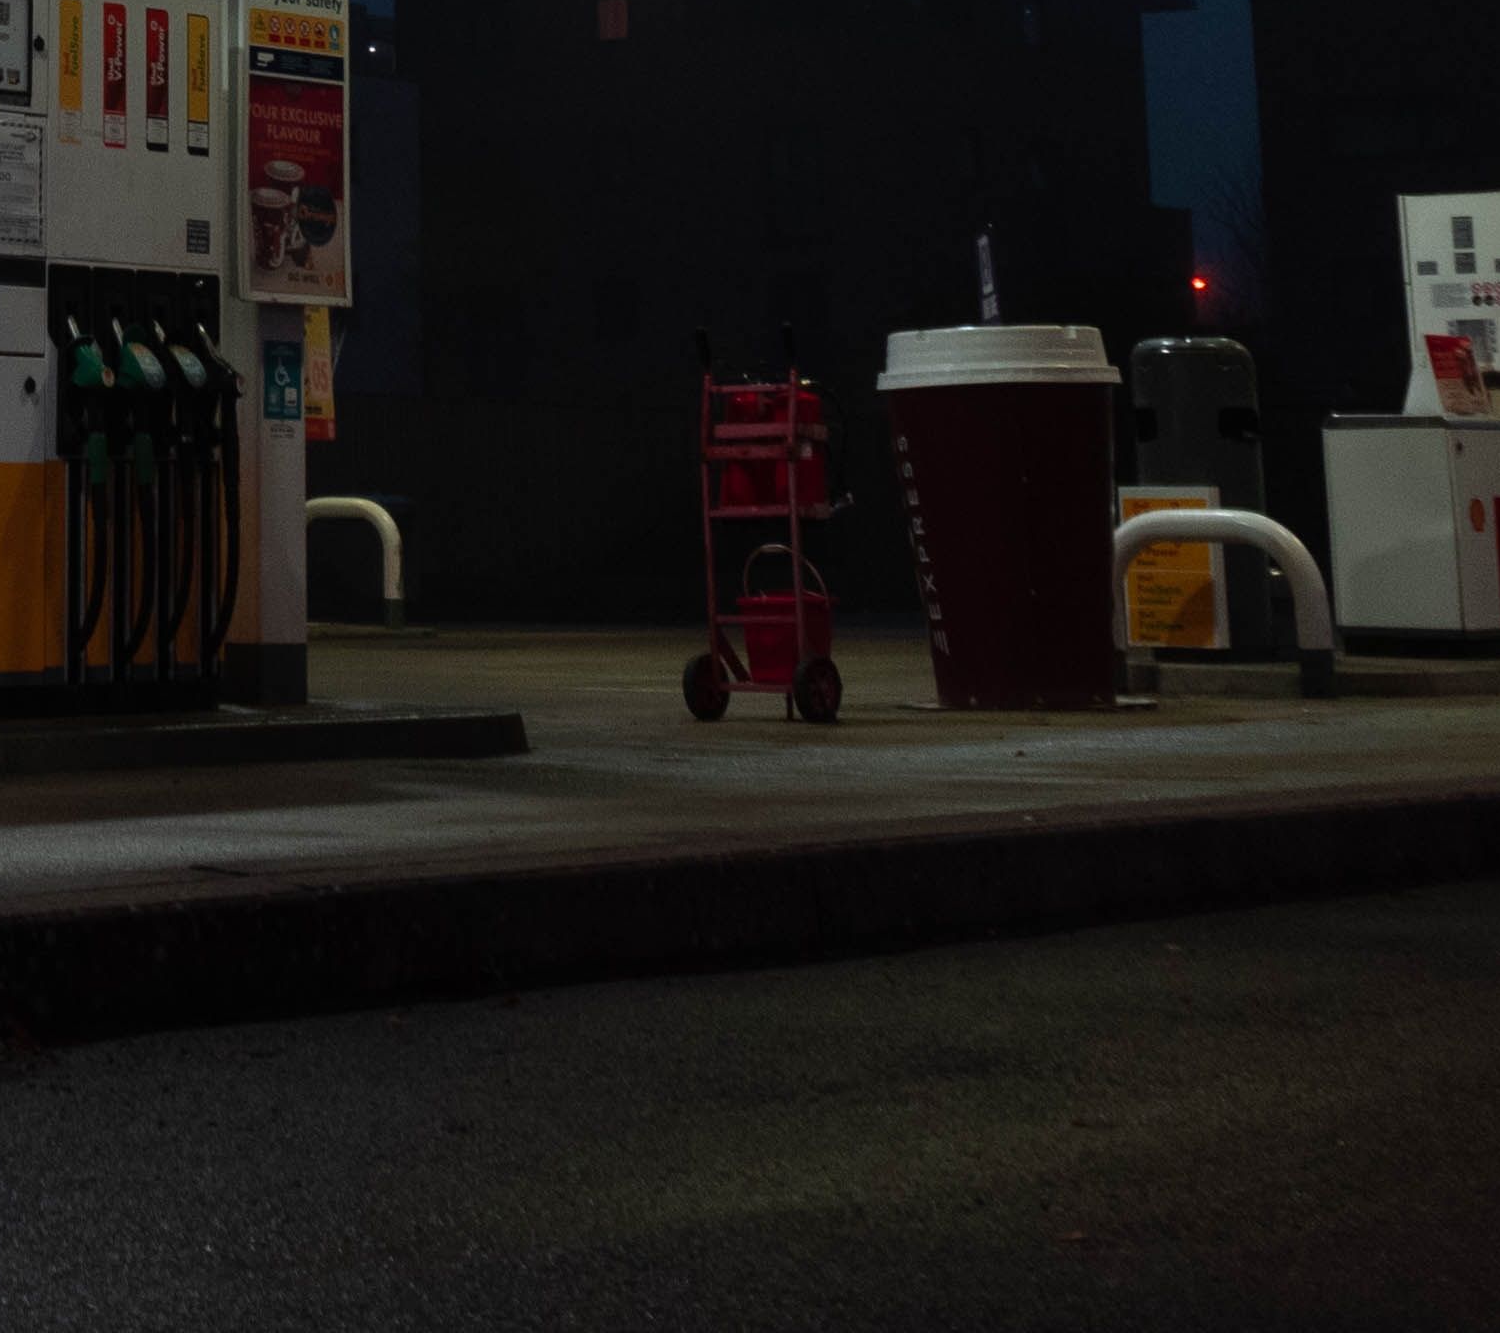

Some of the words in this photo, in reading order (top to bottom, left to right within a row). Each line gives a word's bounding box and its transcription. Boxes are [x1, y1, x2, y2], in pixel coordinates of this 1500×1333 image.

[112, 22, 124, 81] V-Power
[156, 27, 167, 85] V-Power
[267, 125, 321, 144] FLAVOUR
[281, 107, 343, 128] EXCLUSIVE
[896, 434, 943, 621] EXPRESS
